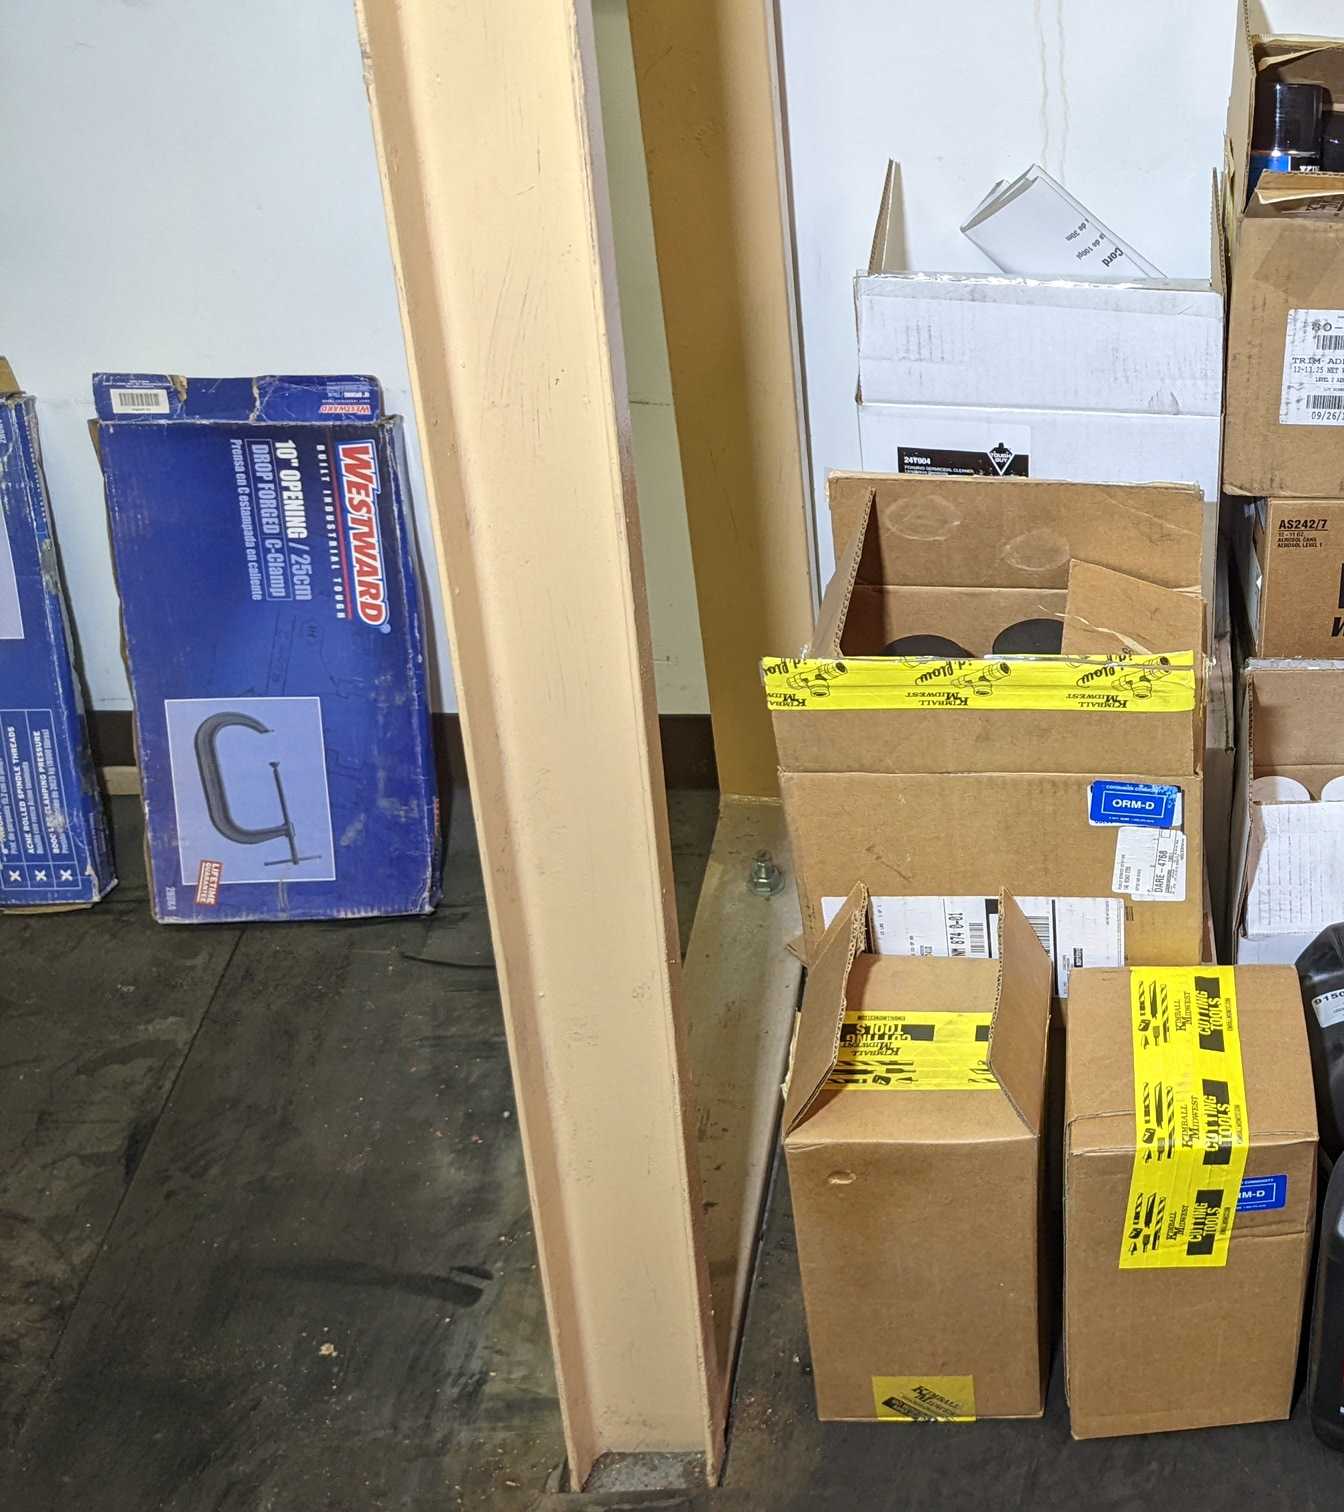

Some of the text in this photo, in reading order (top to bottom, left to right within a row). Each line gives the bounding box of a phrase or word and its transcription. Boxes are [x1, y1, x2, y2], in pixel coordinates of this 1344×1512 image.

[274, 440, 300, 467] 10"
[230, 439, 246, 472] Prensa
[239, 495, 256, 550] estampada
[248, 563, 262, 600] caliente
[251, 444, 287, 598] DROP FORGED C-Clamp
[279, 470, 308, 540] OPENING
[1278, 519, 1328, 529] AS242/7
[316, 444, 346, 619] BUILT INDUSTRIAL TOUGH
[338, 442, 389, 626] WESTWARD
[291, 554, 313, 601] 25cm
[905, 691, 960, 702] MIDWEST
[918, 697, 969, 707] KIMBALL
[1066, 693, 1120, 703] MIDWEST
[1078, 699, 1129, 709] KIMBALL
[8, 726, 20, 764] THREADS
[33, 731, 47, 774] PRESSURE
[14, 766, 27, 800] SPINDLE
[20, 801, 32, 830] ROLLED
[1112, 799, 1155, 810] ORM-D
[207, 863, 220, 905] LIFETIME
[856, 1024, 904, 1035] TOOLS
[1196, 991, 1211, 1035] CUTTING
[1208, 998, 1223, 1030] TOOLS
[846, 1034, 912, 1043] CUTTING
[1180, 1104, 1193, 1149] KIMBALL
[1189, 1095, 1200, 1140] MIDWEST
[1203, 1095, 1219, 1152] CUTTING
[1216, 1103, 1233, 1145] TOOLS
[1189, 1202, 1208, 1242] CUTTING
[1203, 1207, 1220, 1236] TOOLS
